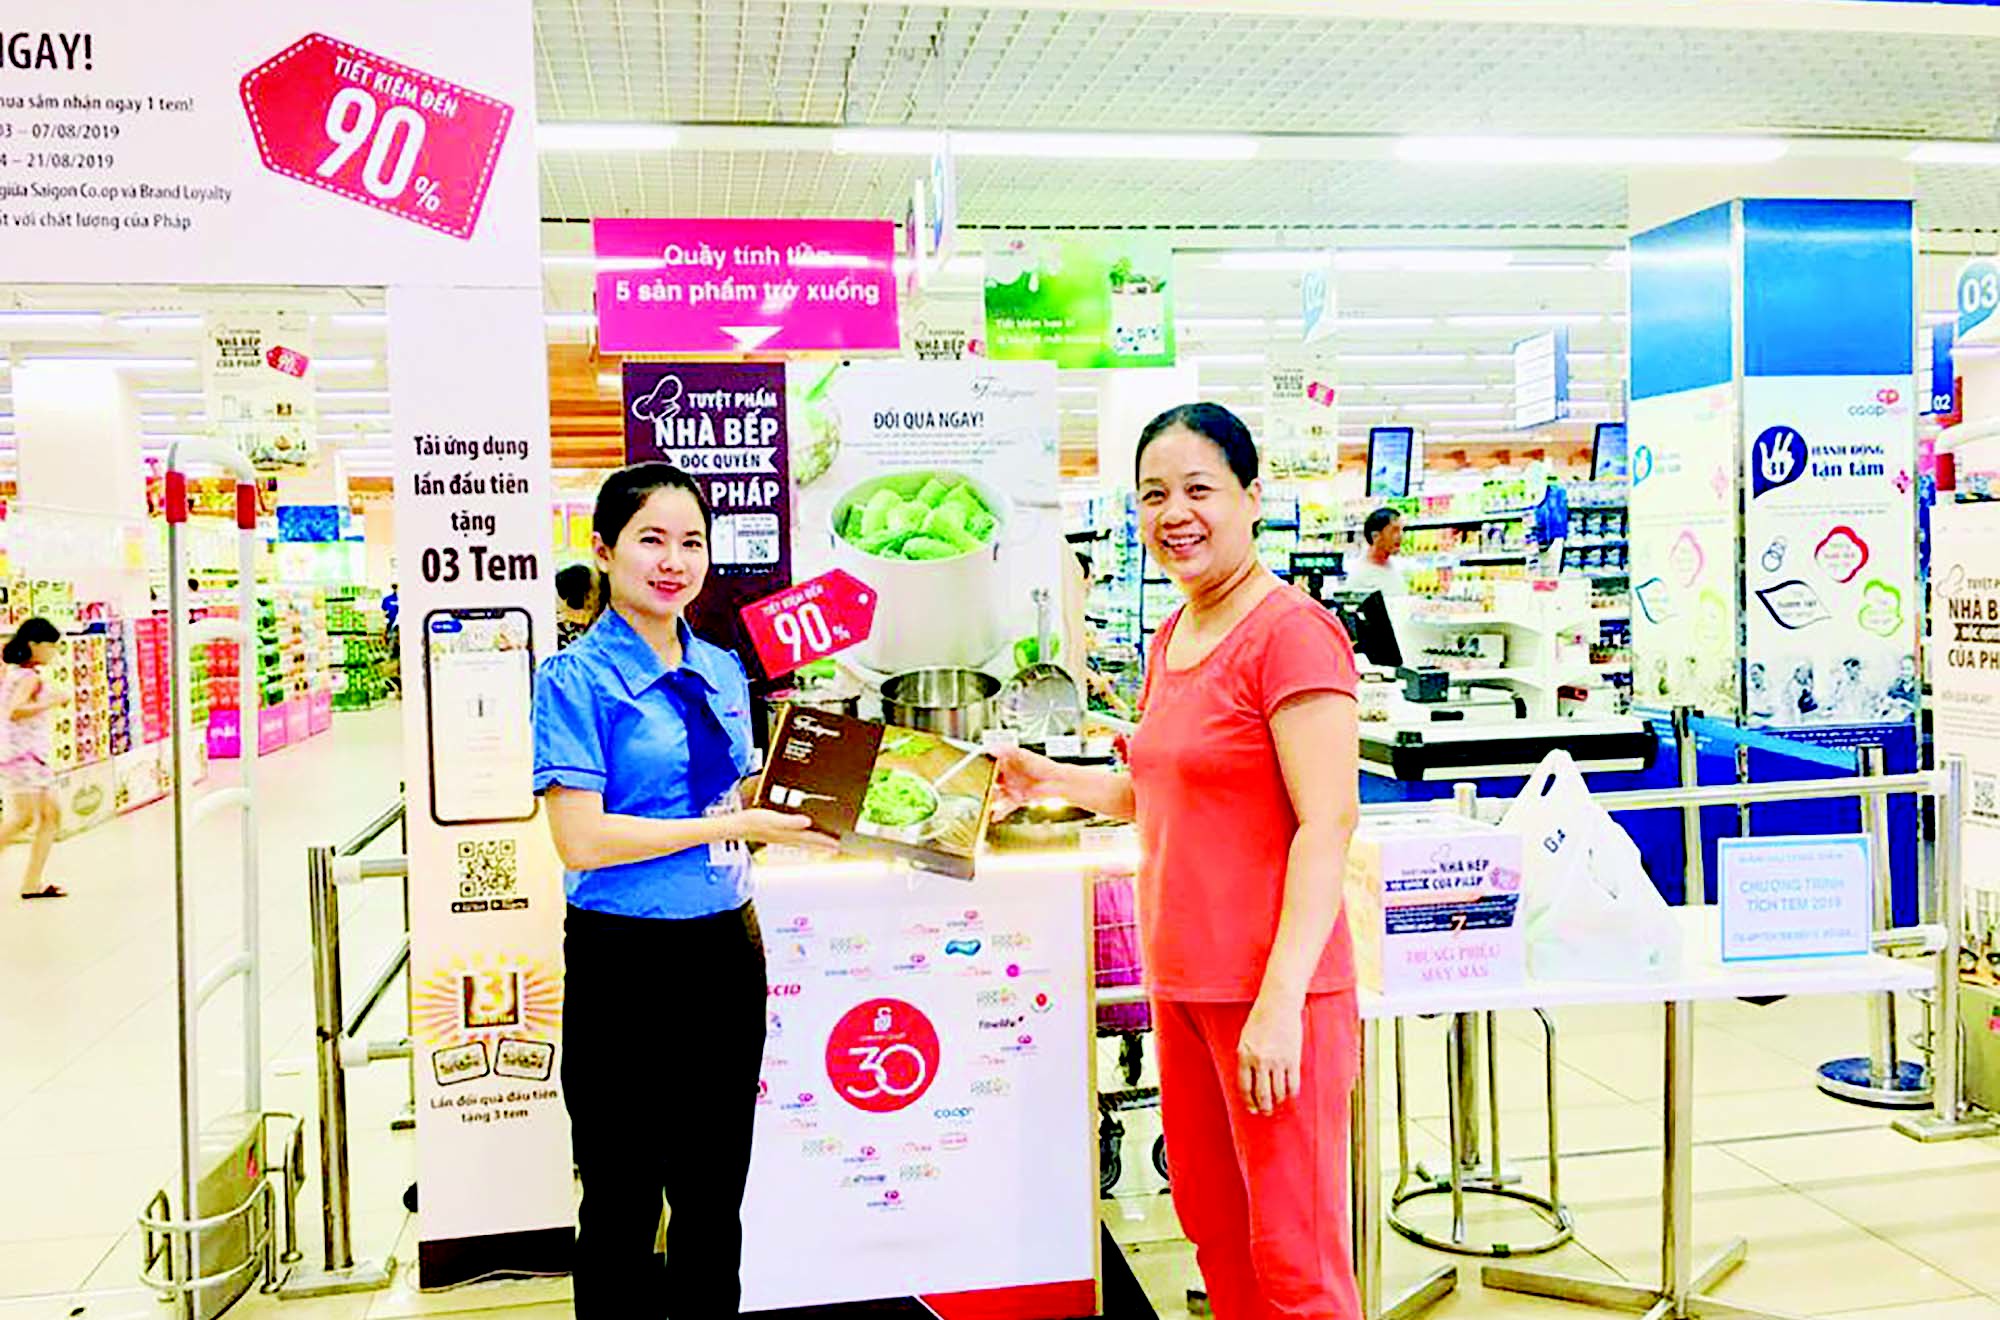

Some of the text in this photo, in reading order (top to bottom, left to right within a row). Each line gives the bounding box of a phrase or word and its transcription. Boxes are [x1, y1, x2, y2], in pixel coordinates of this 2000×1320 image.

[0, 33, 92, 70] GAY!
[32, 123, 120, 139] 07/08/2019
[27, 153, 114, 169] 21/08/2019
[31, 182, 78, 200] Saigon
[141, 183, 181, 200] Brand
[184, 185, 232, 203] Loyalty
[664, 242, 726, 270] Quầy
[733, 245, 780, 266] tính
[616, 280, 630, 301] 5
[638, 278, 682, 301] sản
[690, 276, 756, 305] phẩm
[807, 277, 880, 305] xuống
[1963, 273, 1998, 314] 03
[688, 389, 732, 412] TUYỆT
[655, 407, 778, 447] NHÀ BẾP
[939, 410, 984, 428] NGAY!
[414, 434, 440, 455] Tải
[483, 435, 528, 461] dụng
[710, 475, 780, 507] PHÁP
[422, 546, 538, 582] 03 Tem
[1948, 593, 1982, 620] NHÀ
